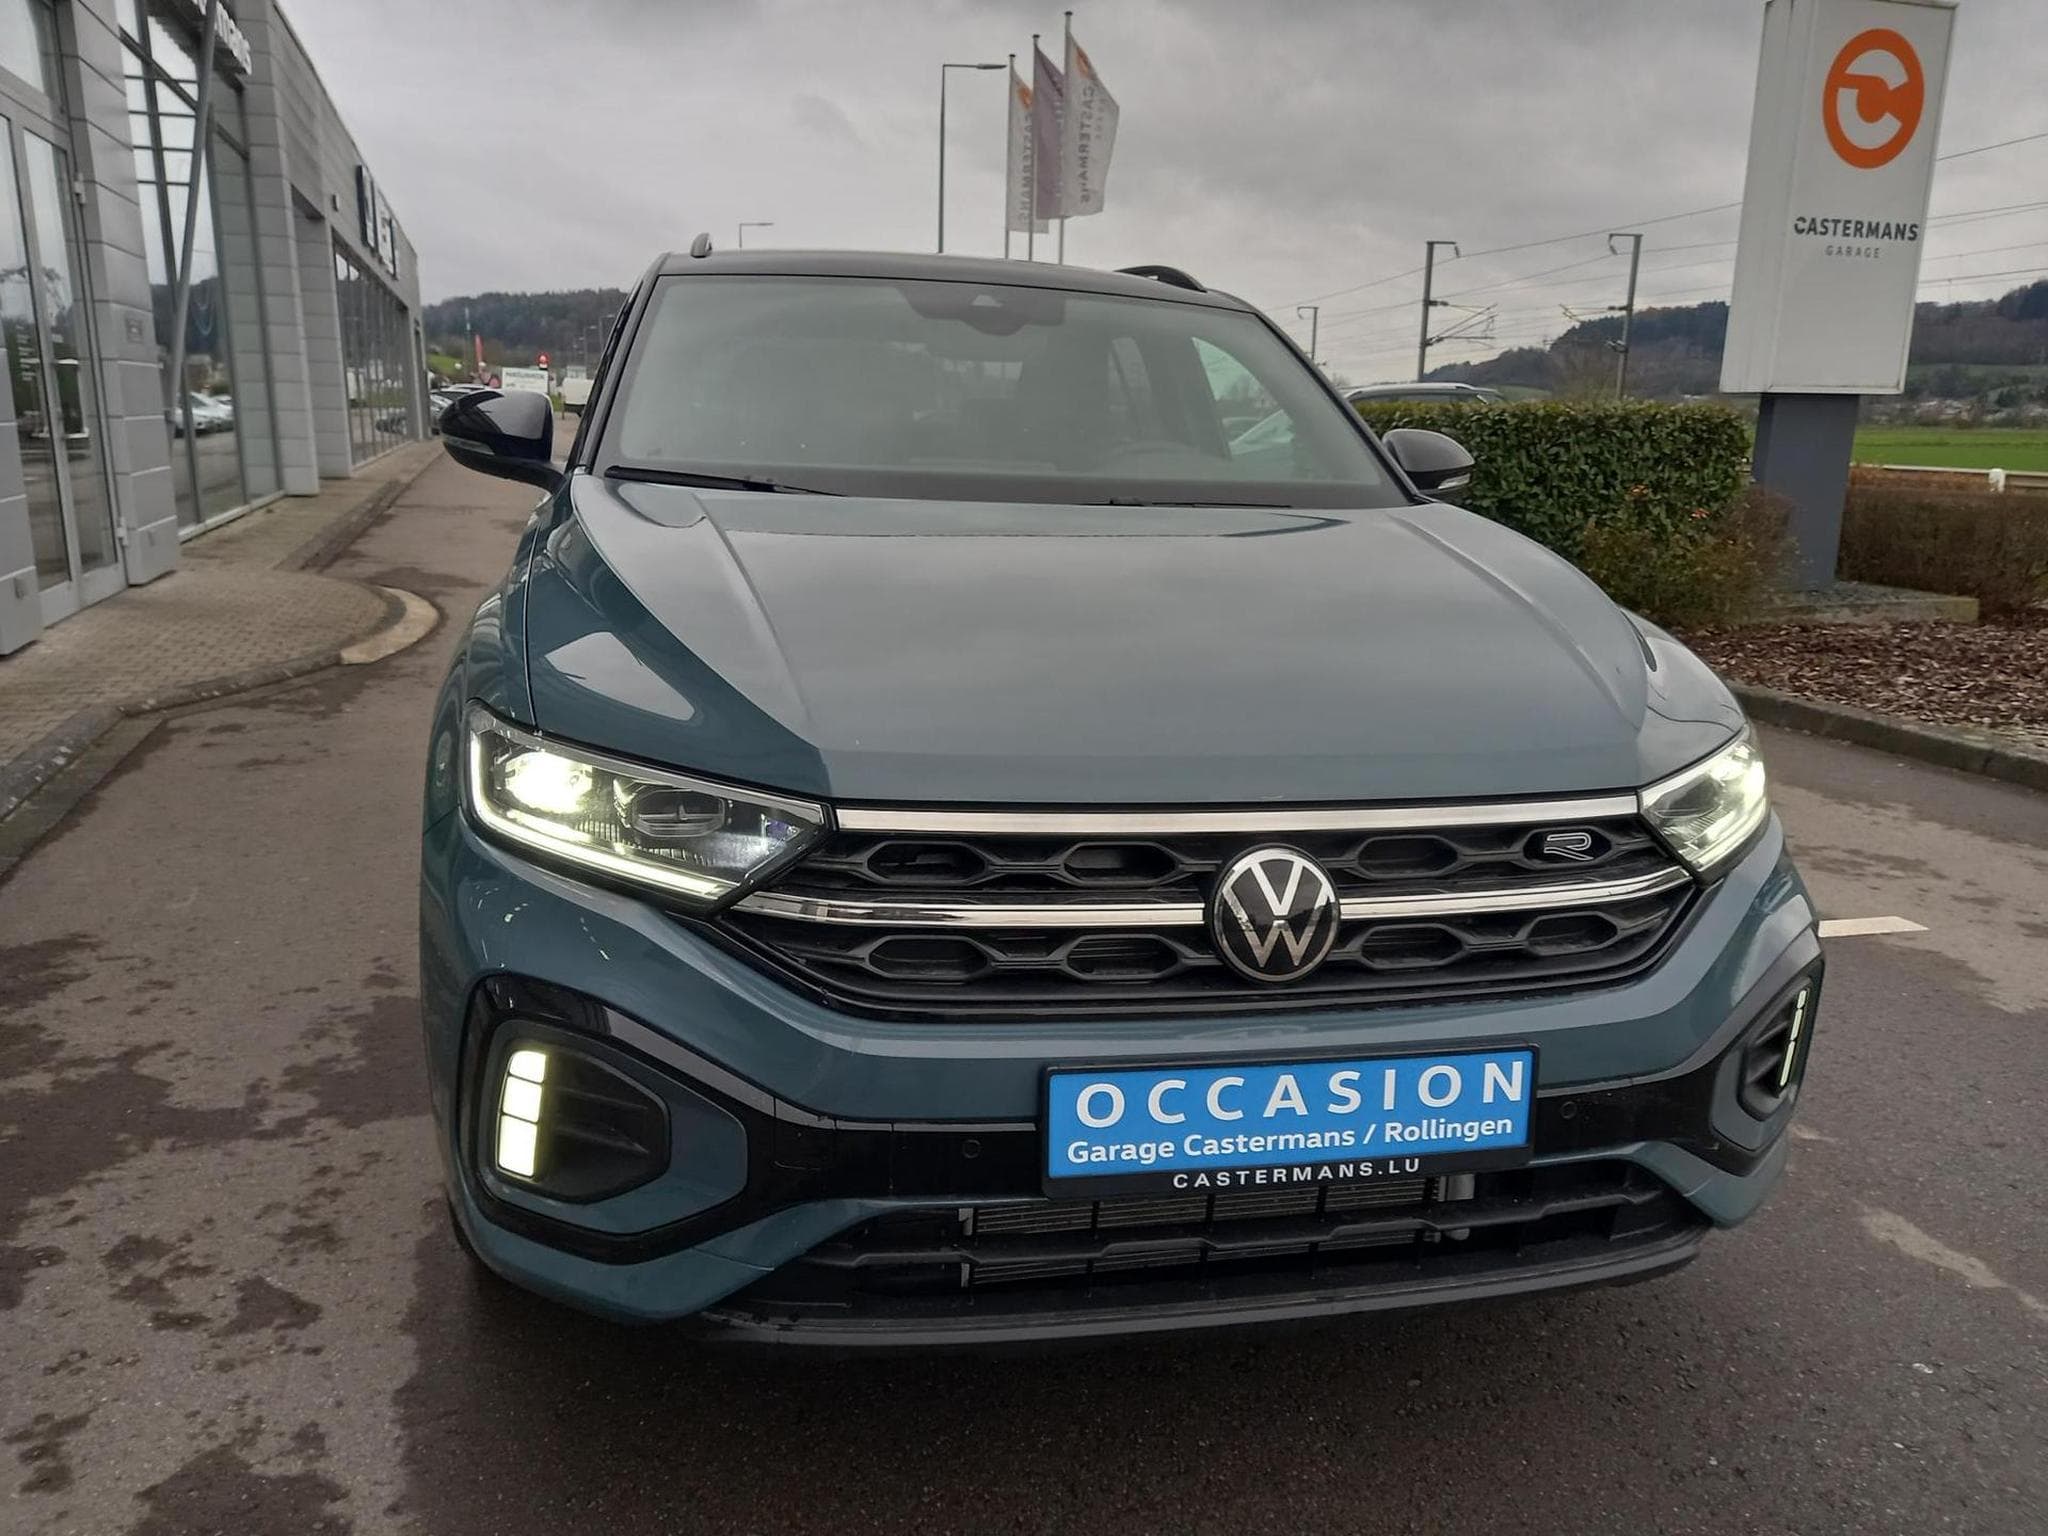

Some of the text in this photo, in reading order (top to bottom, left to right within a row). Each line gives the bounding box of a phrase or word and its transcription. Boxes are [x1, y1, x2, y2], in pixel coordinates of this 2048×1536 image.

[1794, 216, 1919, 241] CASTERMANS
[1825, 245, 1880, 258] GARAGE
[1076, 1060, 1524, 1128] OCCASION
[1067, 1118, 1512, 1165] Garage Castermans / Rollingen
[1173, 1158, 1420, 1188] CASTERMANS.LU
